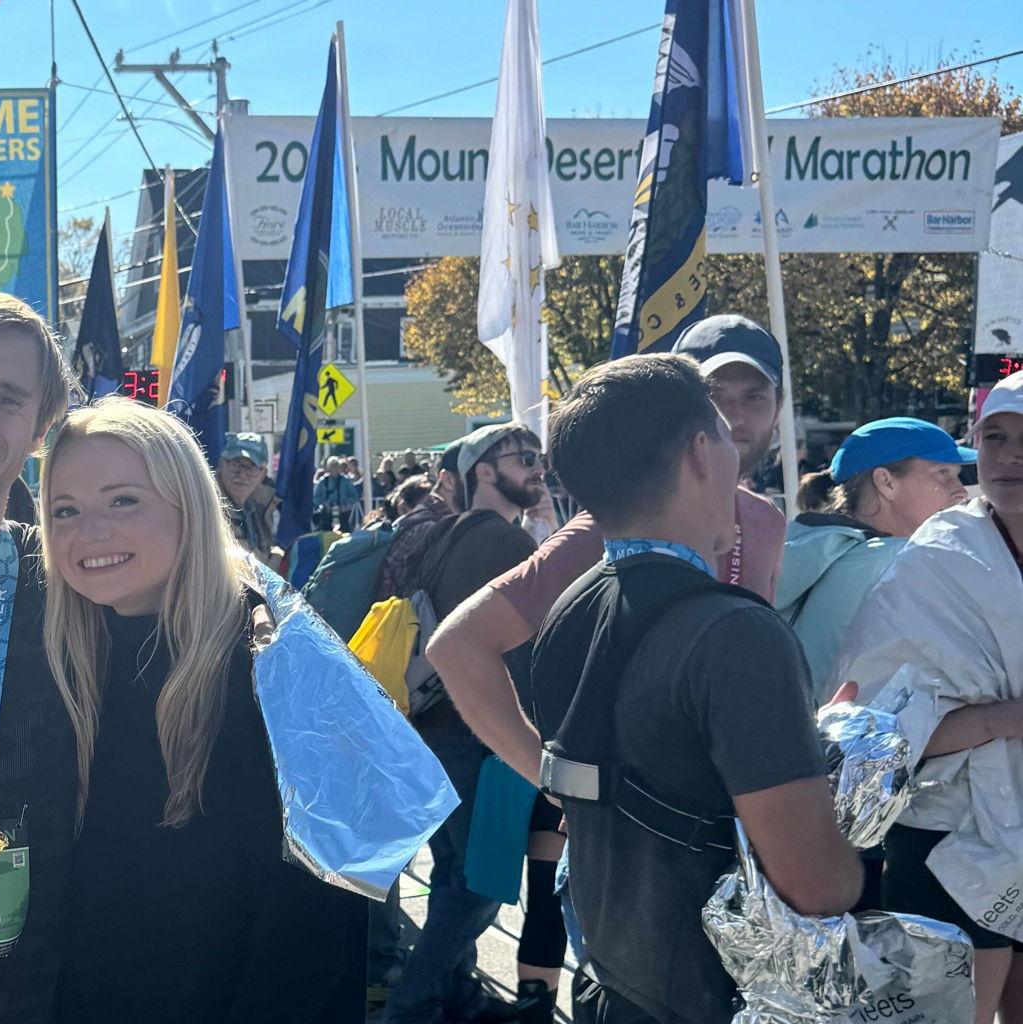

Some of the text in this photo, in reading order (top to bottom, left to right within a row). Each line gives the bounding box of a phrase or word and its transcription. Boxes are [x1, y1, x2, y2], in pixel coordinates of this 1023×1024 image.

[380, 134, 490, 182] Moun
[545, 136, 644, 182] esert
[785, 135, 971, 182] Marathon
[729, 524, 741, 585] NISHER
